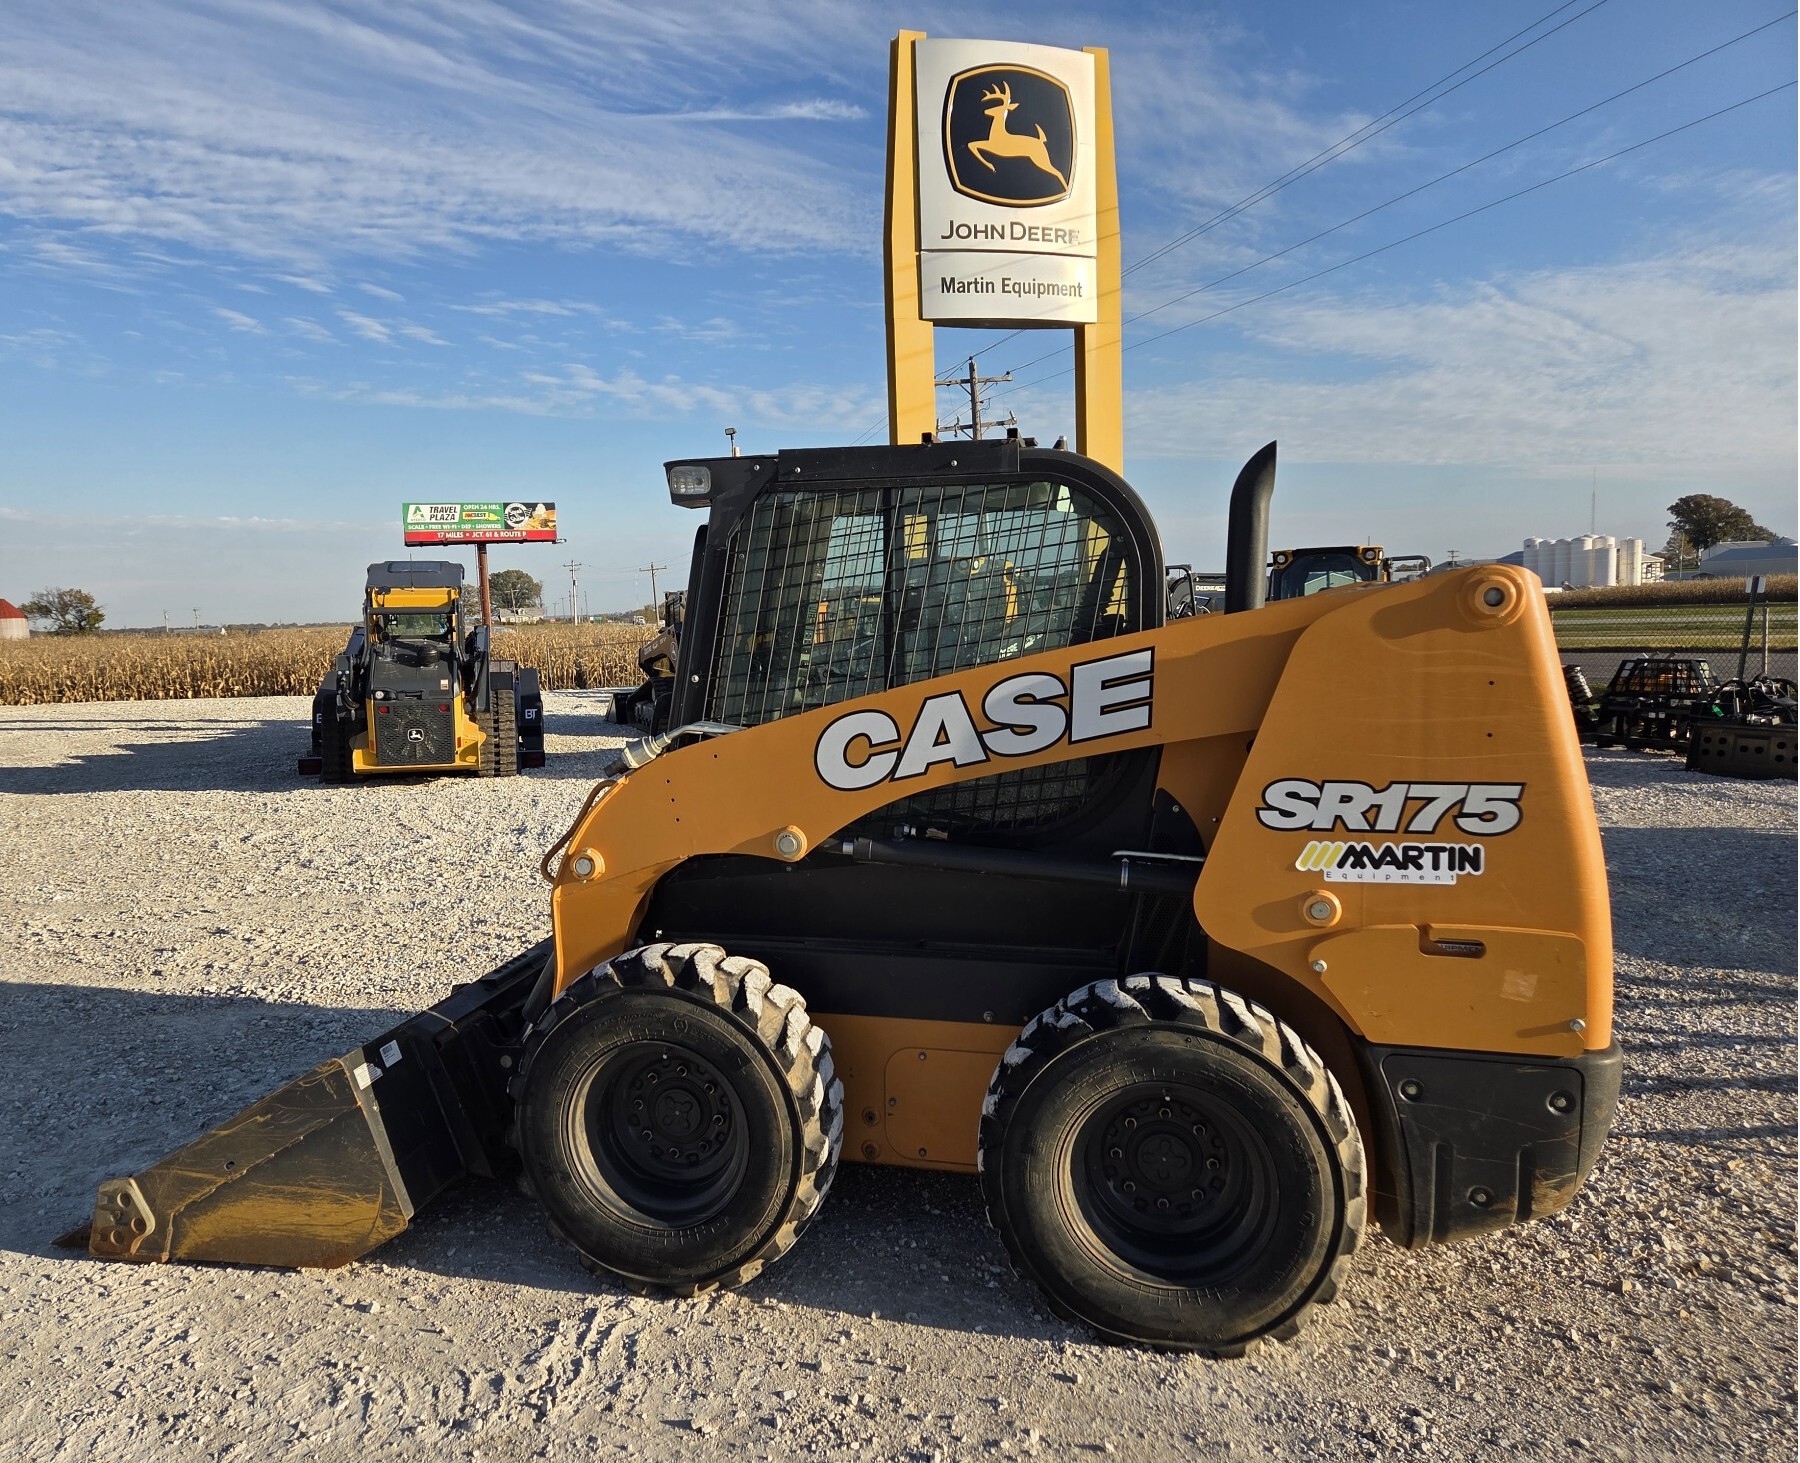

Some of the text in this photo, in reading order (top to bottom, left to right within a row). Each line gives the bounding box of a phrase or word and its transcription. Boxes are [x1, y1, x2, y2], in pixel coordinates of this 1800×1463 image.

[940, 219, 1080, 244] JOHN DEERE
[941, 276, 1083, 299] Martin Equipment
[429, 505, 458, 514] TRAVEL
[429, 513, 456, 521] PLAZA
[814, 646, 1155, 791] CASE
[1255, 778, 1527, 836] SR175
[1337, 844, 1482, 871] MARTIN
[1325, 872, 1455, 882] Equipment
